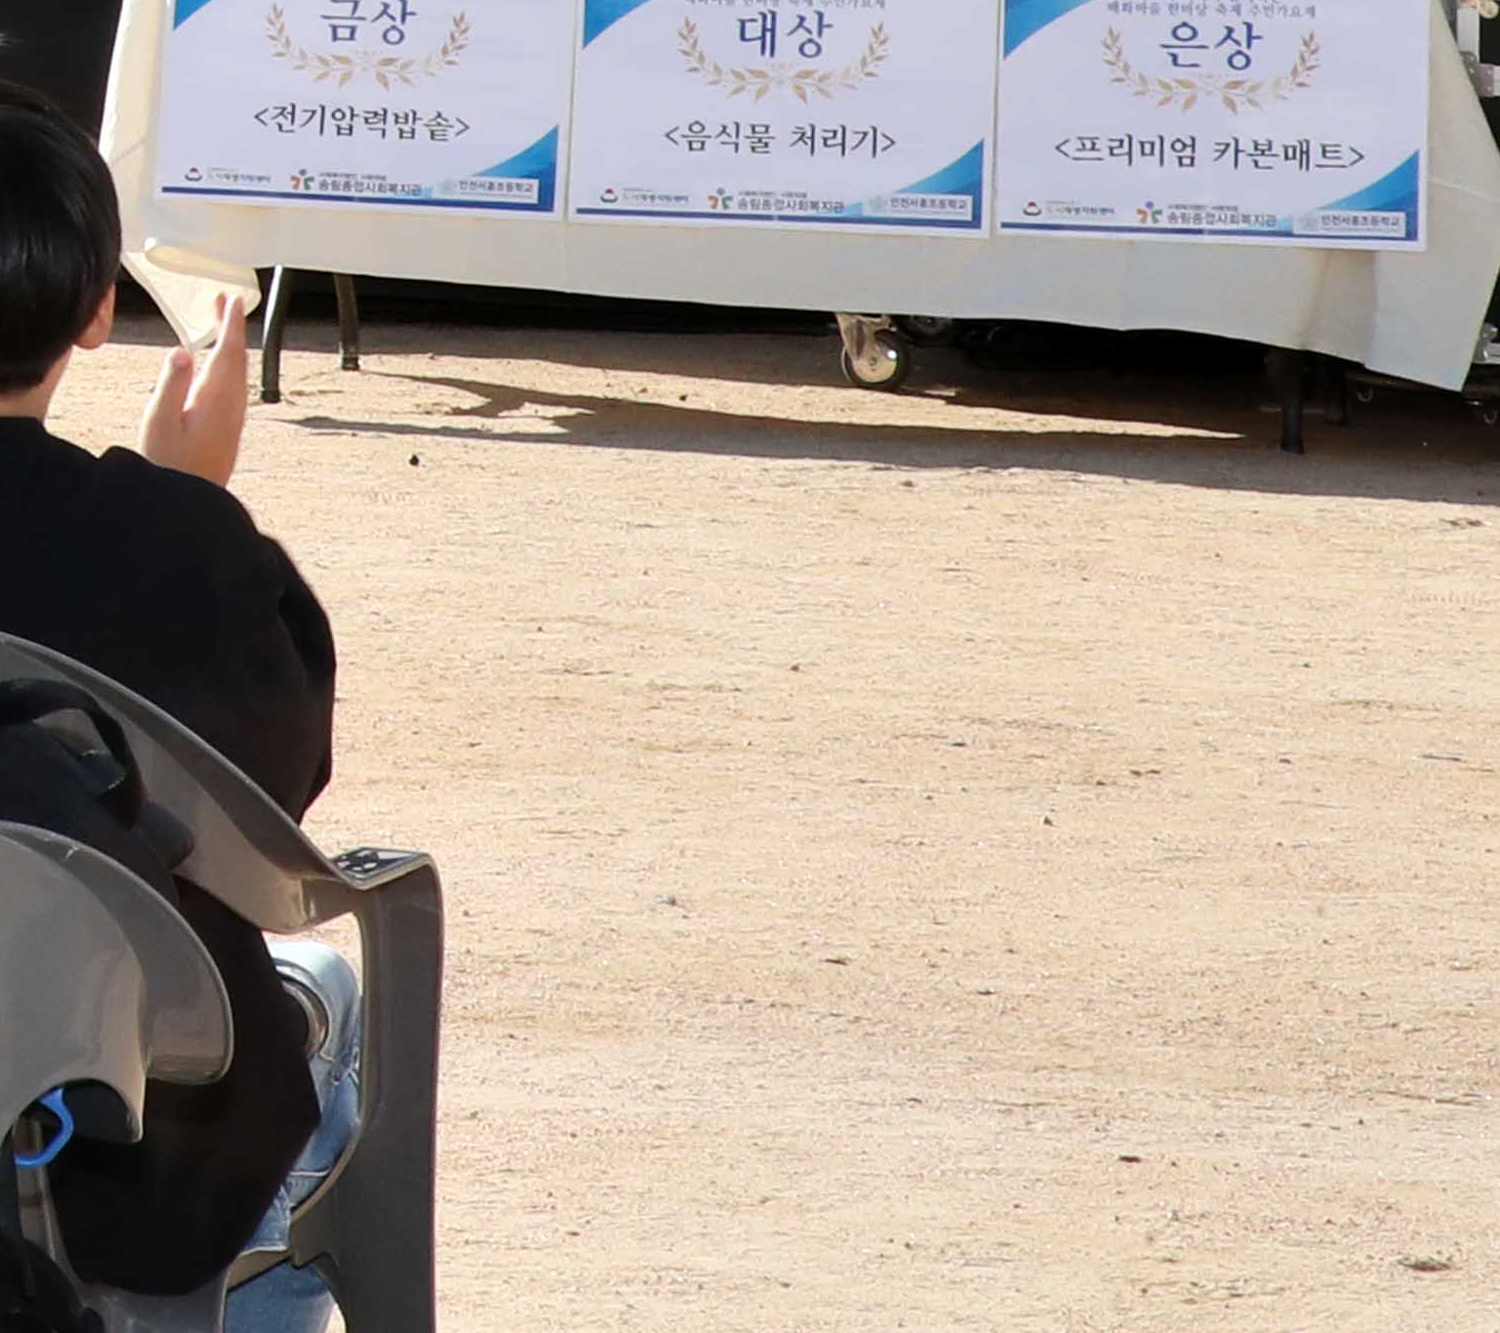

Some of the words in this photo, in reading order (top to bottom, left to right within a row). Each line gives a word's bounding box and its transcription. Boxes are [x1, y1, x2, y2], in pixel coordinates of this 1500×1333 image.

[737, 9, 834, 59] 대상
[1159, 21, 1263, 71] 은상
[253, 103, 470, 141] <전기압력밥솥>
[664, 121, 776, 154] <음식물
[790, 122, 896, 159] 처리기>
[1055, 133, 1198, 167] <프리미엄
[1213, 136, 1364, 171] 카본매트>
